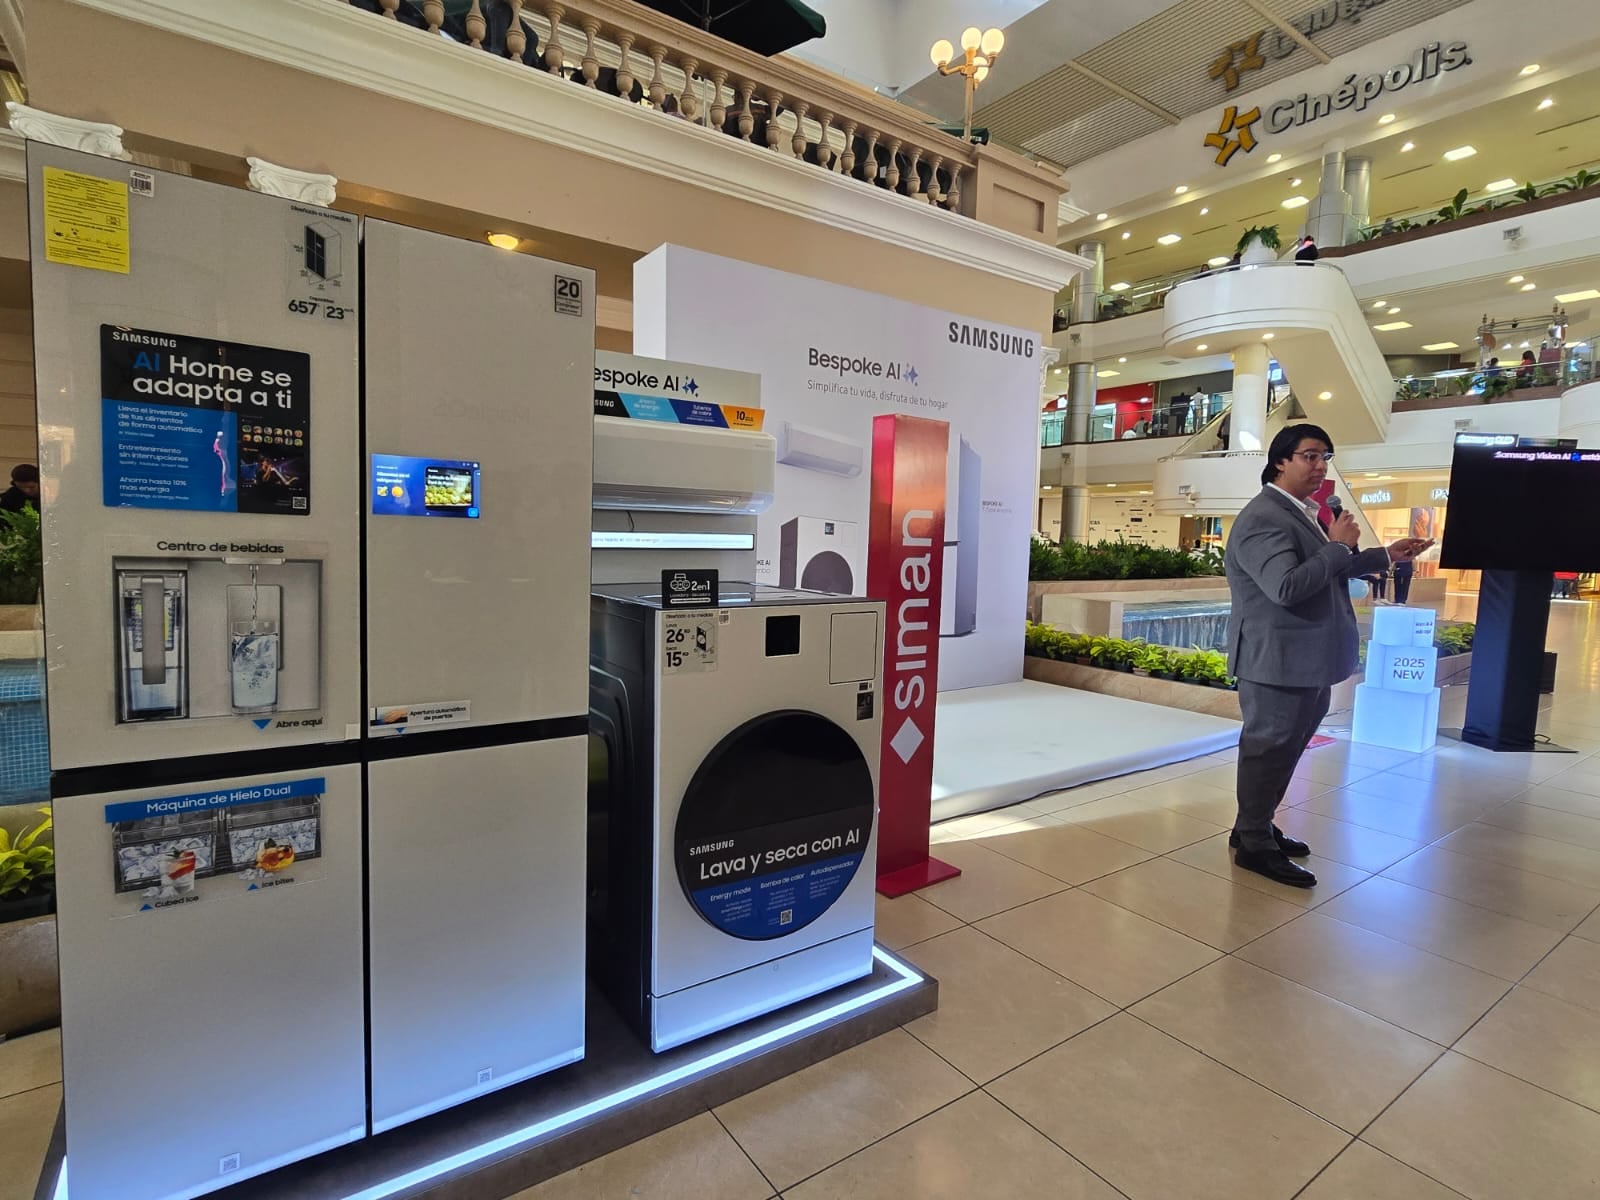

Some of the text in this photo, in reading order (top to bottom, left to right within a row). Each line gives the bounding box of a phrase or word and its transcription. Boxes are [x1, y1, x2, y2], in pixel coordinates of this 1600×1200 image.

[558, 278, 580, 298] 20
[288, 300, 344, 320] 657 23
[112, 331, 177, 348] SAMSUNG
[948, 321, 1034, 358] SAMSUNG
[133, 351, 292, 387] AI Home se
[808, 348, 901, 380] Bespoke AI
[662, 375, 679, 392] AI
[132, 376, 292, 409] adapta a ti
[808, 380, 848, 396] Simplifica
[850, 387, 858, 396] tu
[880, 391, 908, 404] disfruta
[909, 395, 918, 405] de
[920, 398, 928, 406] tu
[736, 410, 746, 420] 10
[1494, 451, 1536, 460] Samsung
[1536, 452, 1560, 460] Vision
[156, 540, 284, 554] Centro de bebidas
[666, 629, 684, 644] 26
[666, 652, 682, 668] 15
[1394, 658, 1424, 668] 2025
[1393, 670, 1424, 680] NEW
[276, 718, 323, 728] Abre aquí
[146, 785, 291, 814] Máquina de Hielo Dual
[689, 839, 734, 856] SAMSUNG
[700, 828, 860, 880] Lava y seca con AI
